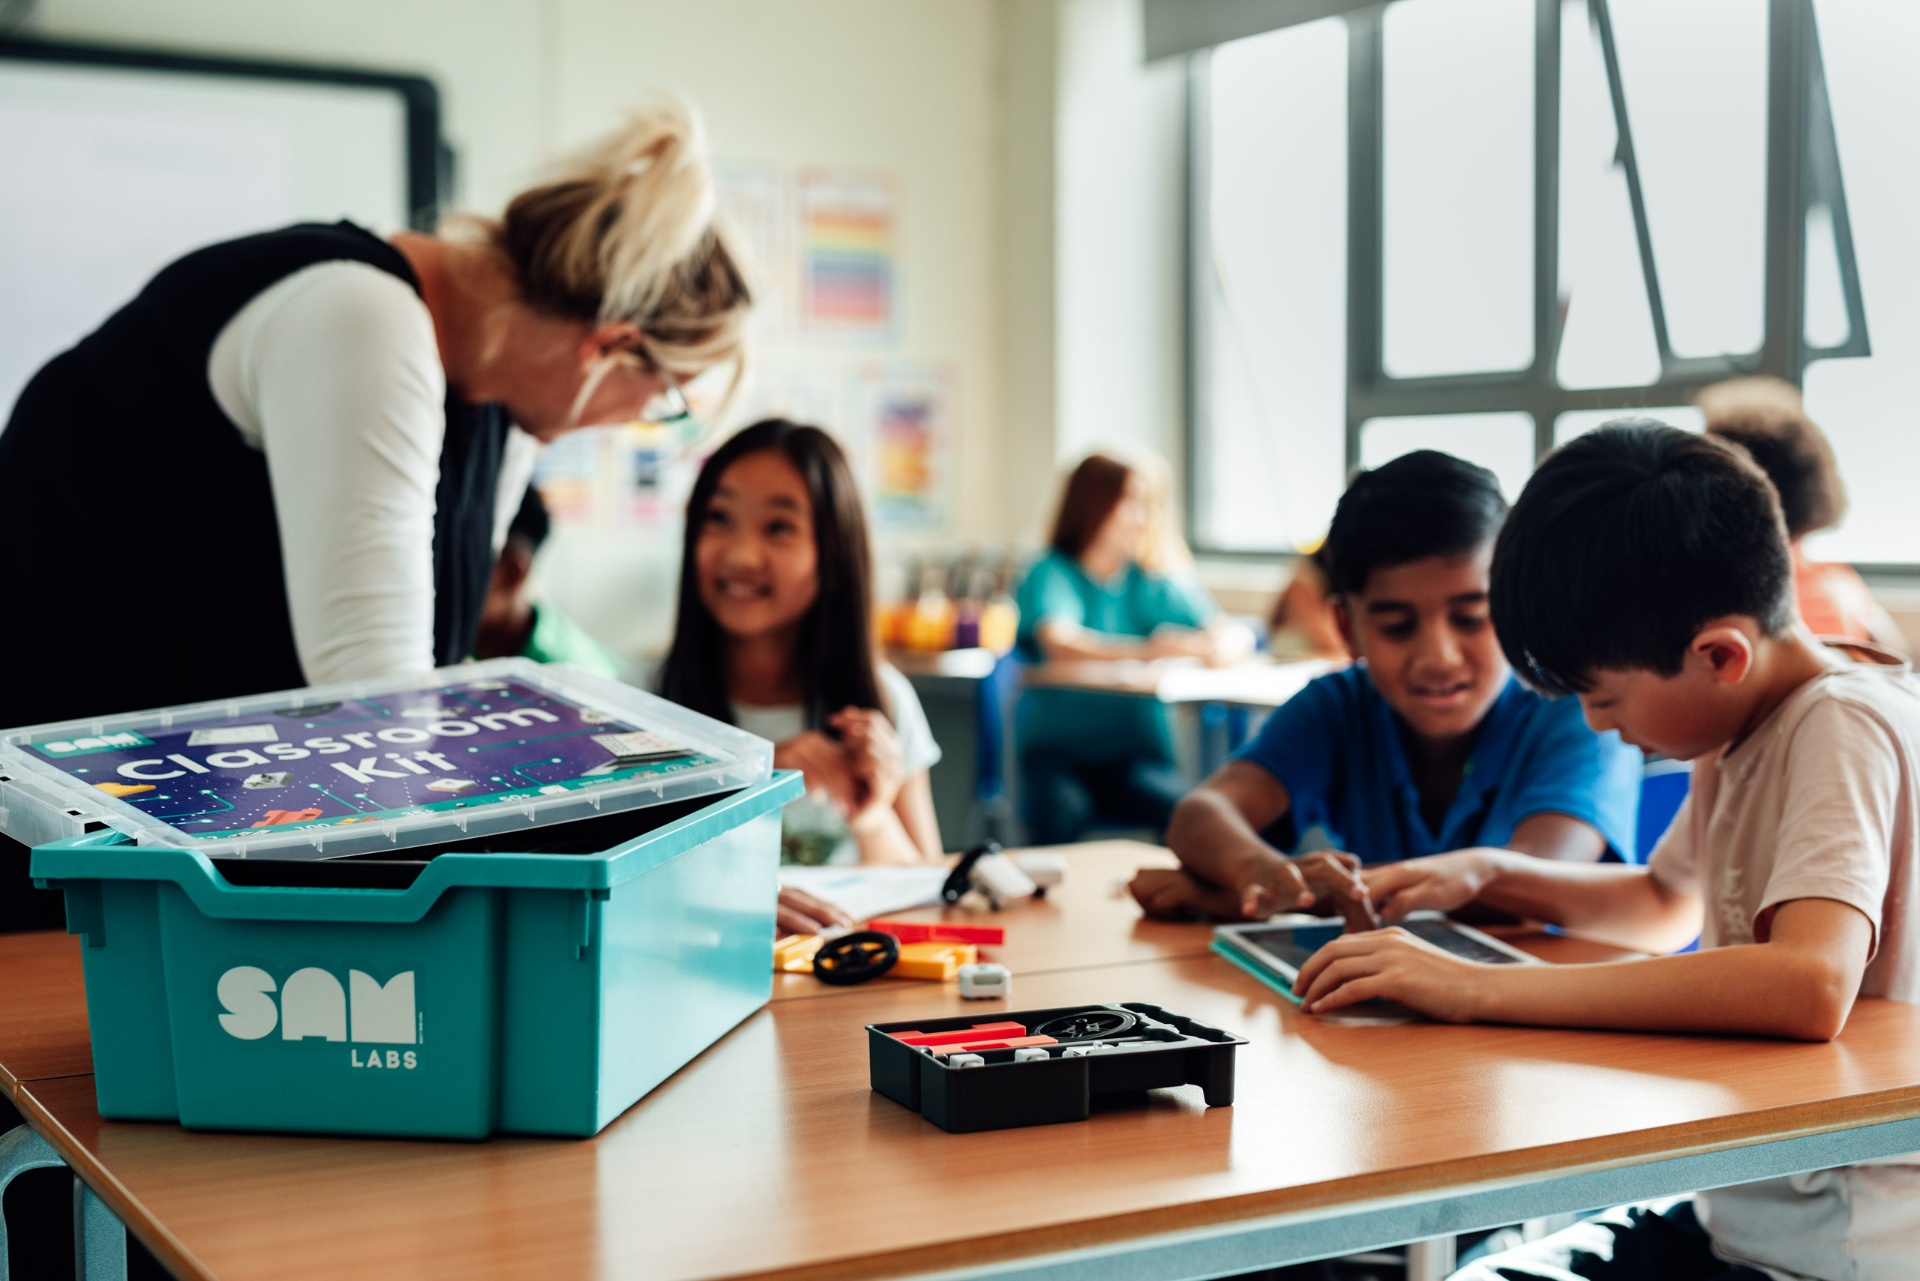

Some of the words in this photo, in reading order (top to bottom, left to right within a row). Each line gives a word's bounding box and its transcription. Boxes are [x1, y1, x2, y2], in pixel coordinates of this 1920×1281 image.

[117, 707, 559, 781] Classroom
[330, 750, 458, 785] Kit
[217, 966, 416, 1044] SAM
[351, 1049, 417, 1069] LABS
